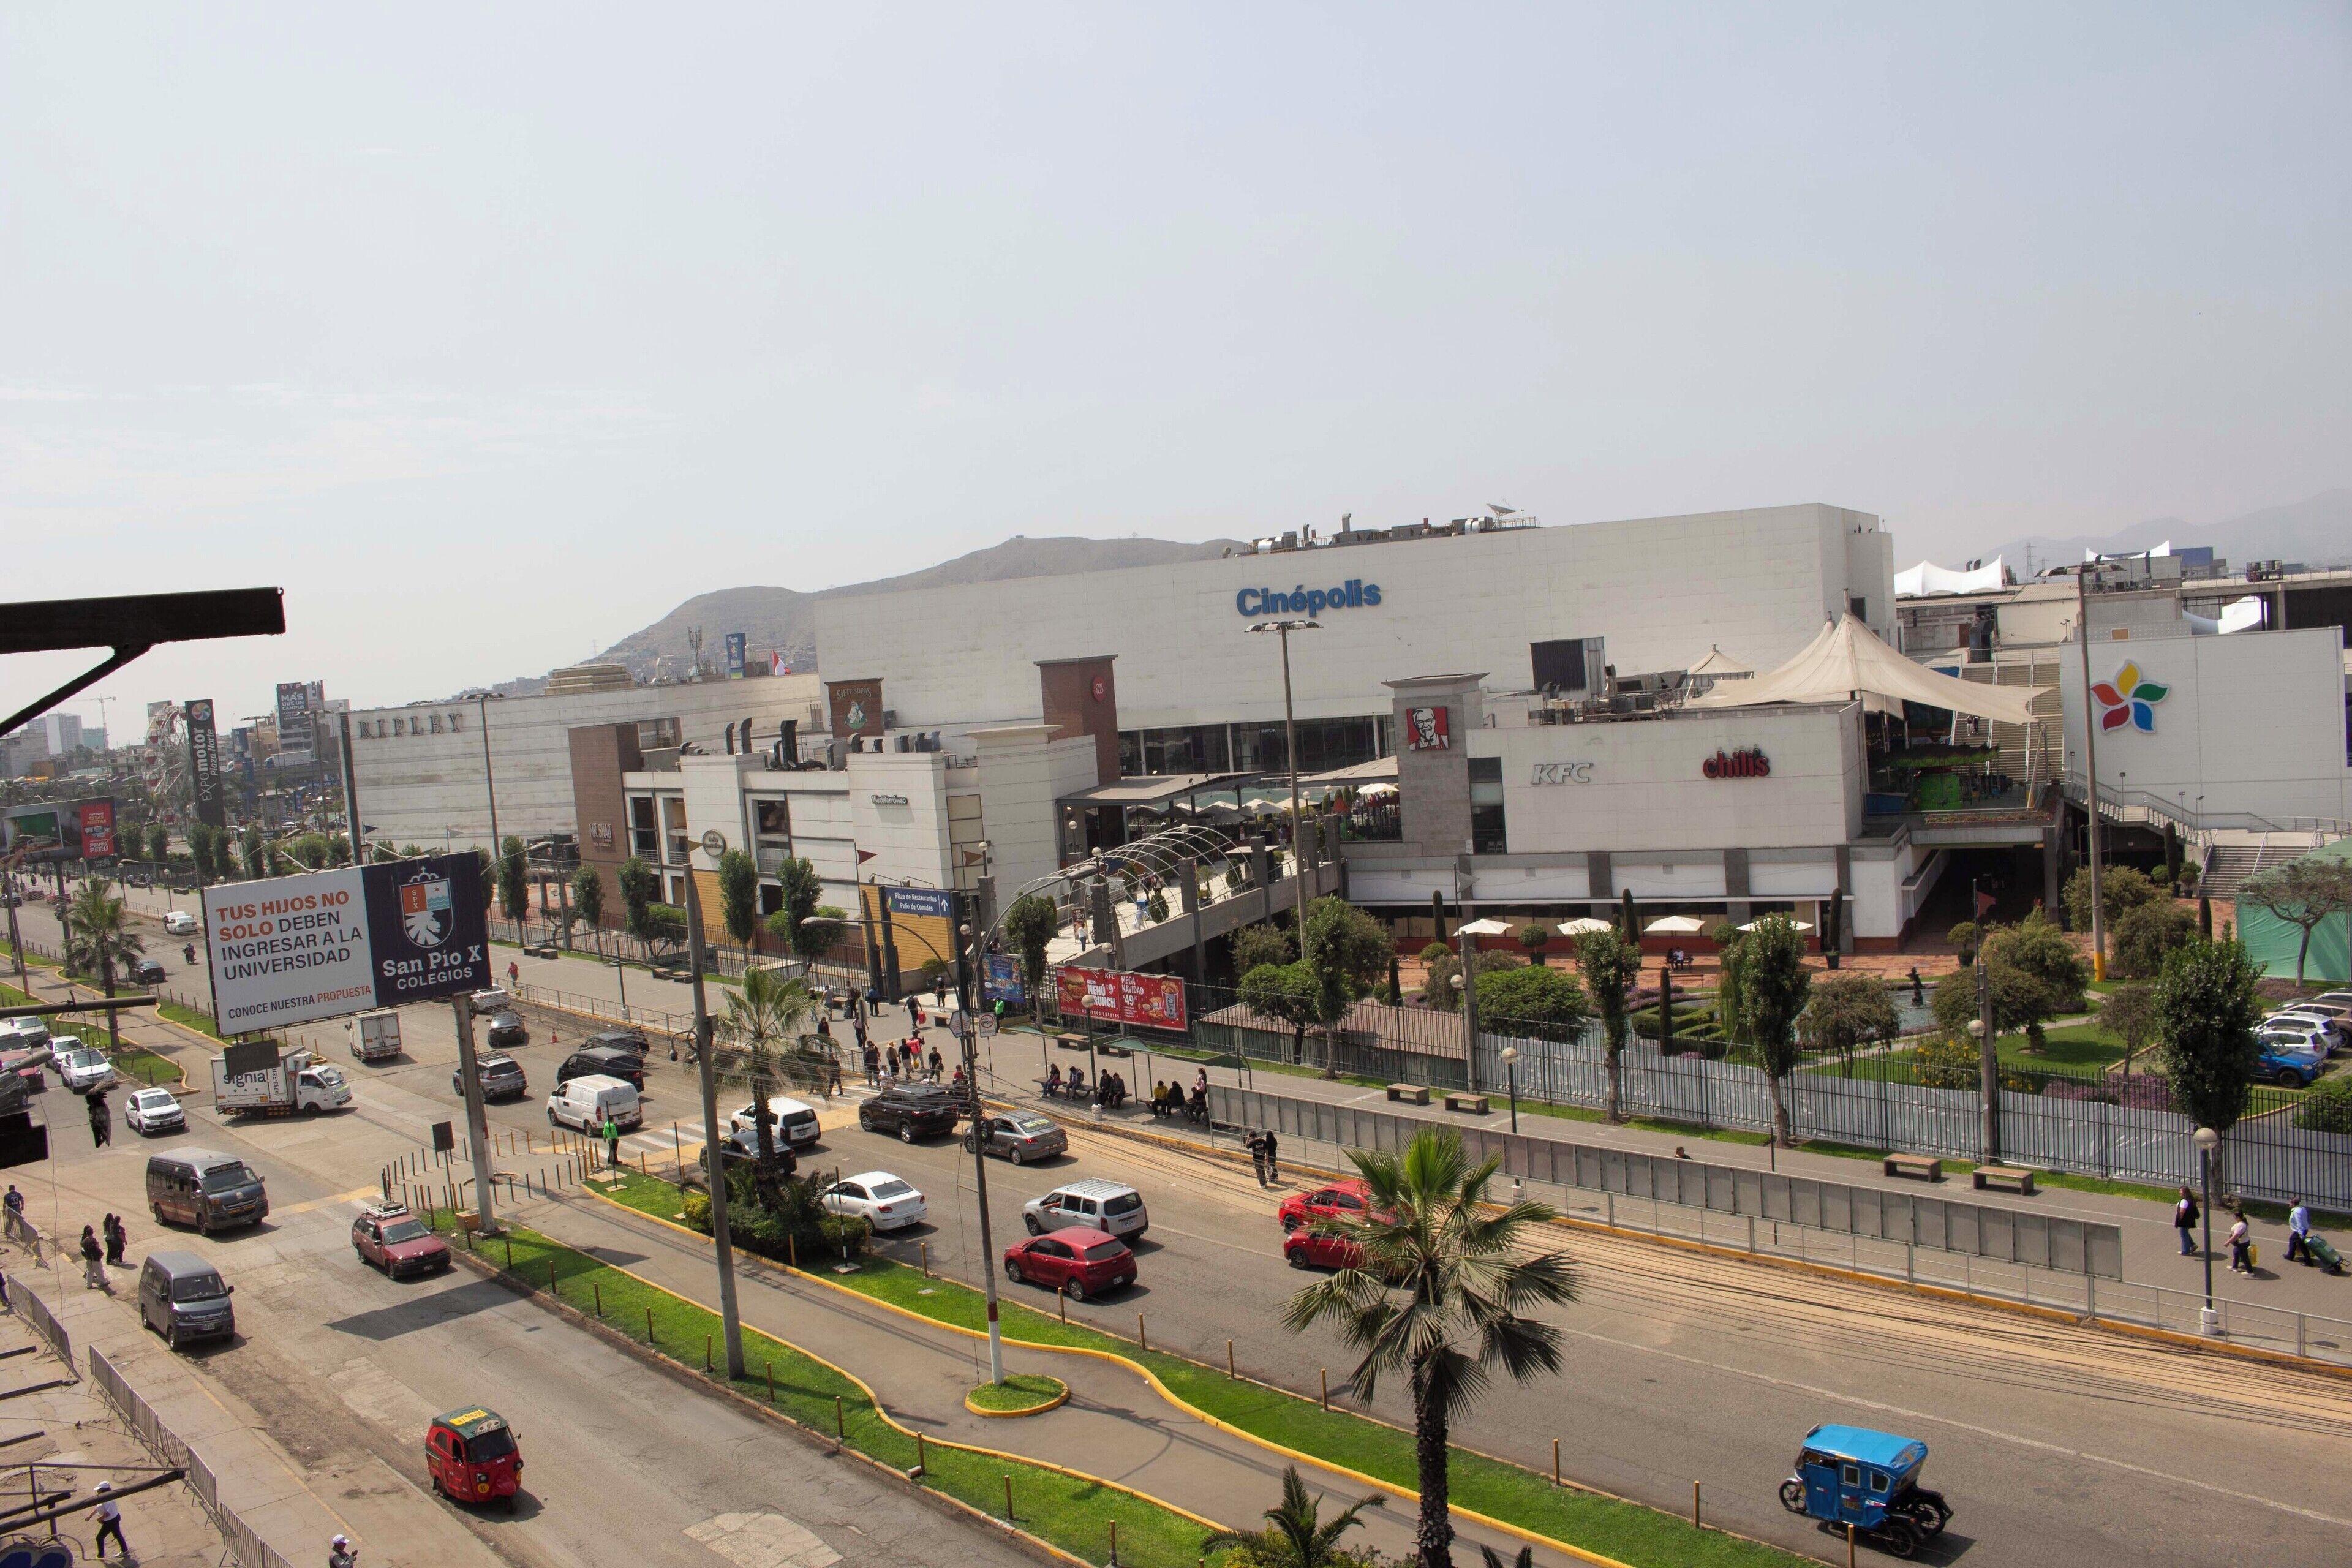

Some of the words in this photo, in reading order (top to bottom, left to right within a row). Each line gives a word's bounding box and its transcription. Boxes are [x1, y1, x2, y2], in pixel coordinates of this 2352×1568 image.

[1236, 579, 1382, 618] Cinépolis
[358, 713, 462, 740] RIPLEY
[207, 729, 216, 751] Norte
[209, 753, 218, 776] Plaza
[1531, 763, 1592, 785] KFC
[1703, 748, 1770, 778] chili's
[216, 903, 257, 922] TUS
[261, 895, 317, 916] HIJOS
[322, 891, 349, 908] NO
[912, 894, 937, 902] Restaurantes
[219, 921, 273, 941] SOLO
[279, 911, 341, 933] DEBEN
[222, 933, 317, 961] INGRESAR
[323, 931, 335, 946] A
[339, 927, 363, 943] LA
[224, 948, 350, 980] UNIVERSIDAD
[383, 959, 423, 976] San
[428, 949, 462, 970] Pío
[467, 944, 482, 963] X
[397, 967, 473, 990] COLEGIOS
[1087, 984, 1106, 996] MENÚ
[1121, 976, 1136, 985] MEGA
[1121, 985, 1144, 995] NAVIDAD
[229, 1003, 268, 1019] CONOCE
[271, 995, 315, 1011] NUESTRA
[317, 985, 372, 1003] PROPUESTA
[1093, 996, 1116, 1008] RUNCH
